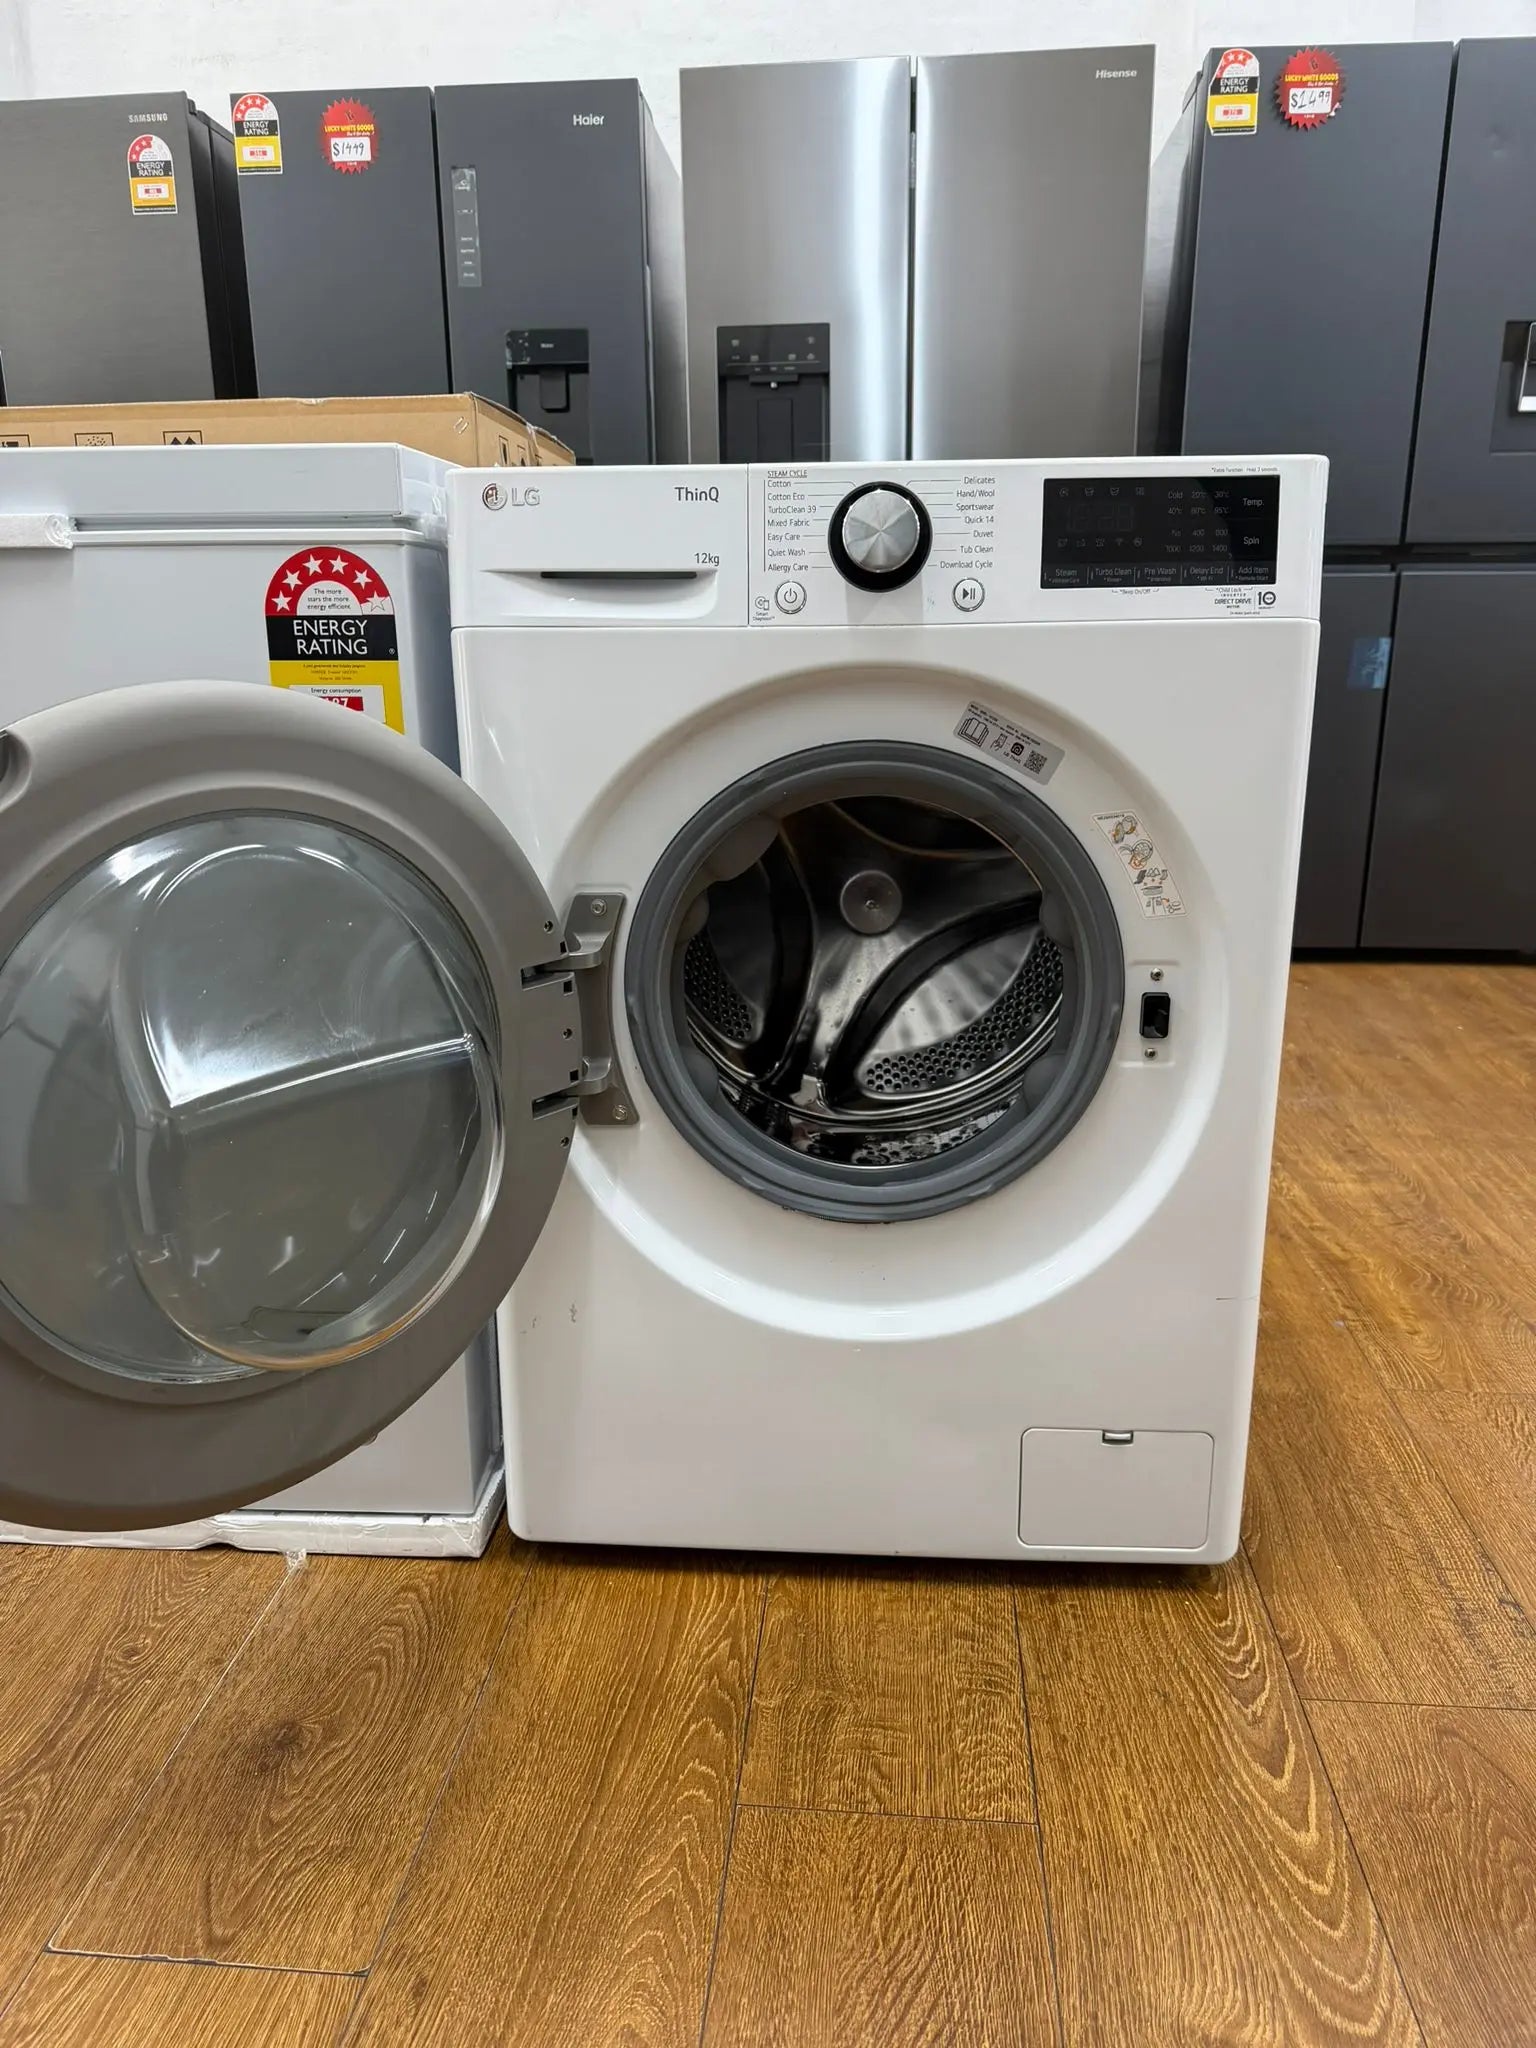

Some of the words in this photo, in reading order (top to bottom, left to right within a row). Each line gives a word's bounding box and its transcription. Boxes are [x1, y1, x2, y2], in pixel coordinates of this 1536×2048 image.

[1095, 69, 1137, 79] Hisense
[1319, 73, 1338, 81] GOODS
[1220, 78, 1249, 86] ENERGY
[1220, 85, 1248, 93] RATING
[128, 112, 168, 123] SAMSUNG
[573, 114, 605, 126] Haier
[243, 121, 269, 129] ENERGY
[136, 162, 165, 170] ENERGY
[767, 470, 788, 478] STEAM
[789, 470, 808, 478] CYCLE
[767, 480, 792, 488] Cotton
[963, 476, 996, 485] Delicates
[511, 487, 541, 507] LG
[674, 486, 719, 503] ThinQ
[767, 493, 792, 501] Cotton
[793, 492, 805, 501] Eco
[956, 489, 995, 498] Hand/Wool
[1167, 490, 1184, 499] Cold
[956, 502, 995, 512] Sportswear
[1242, 497, 1265, 508] Temp.
[768, 505, 806, 514] TurboClean
[807, 505, 817, 514] 39
[767, 519, 788, 527] Mixed
[789, 518, 810, 527] Fabric
[964, 516, 984, 525] Quick
[985, 516, 994, 524] 14
[767, 532, 783, 543] Easy
[784, 532, 801, 541] Care
[973, 530, 994, 538] Duvet
[1243, 536, 1260, 546] Spin
[767, 548, 786, 558] Quiet
[787, 548, 806, 557] Wash
[960, 545, 973, 554] Tub
[974, 545, 994, 554] Clean
[694, 552, 720, 567] 12kg
[767, 563, 791, 574] Allergy
[792, 562, 809, 571] Care
[940, 561, 973, 569] Download
[974, 560, 993, 570] Cycle
[1055, 568, 1078, 577] Steam
[1095, 567, 1113, 576] Turbo
[1113, 567, 1132, 575] Clean
[1156, 567, 1176, 575] Wash
[1190, 567, 1209, 575] Delay
[1210, 567, 1224, 575] End
[1238, 566, 1252, 574] Add
[307, 603, 326, 611] energy
[293, 619, 368, 636] ENERGY
[296, 639, 368, 655] RATING
